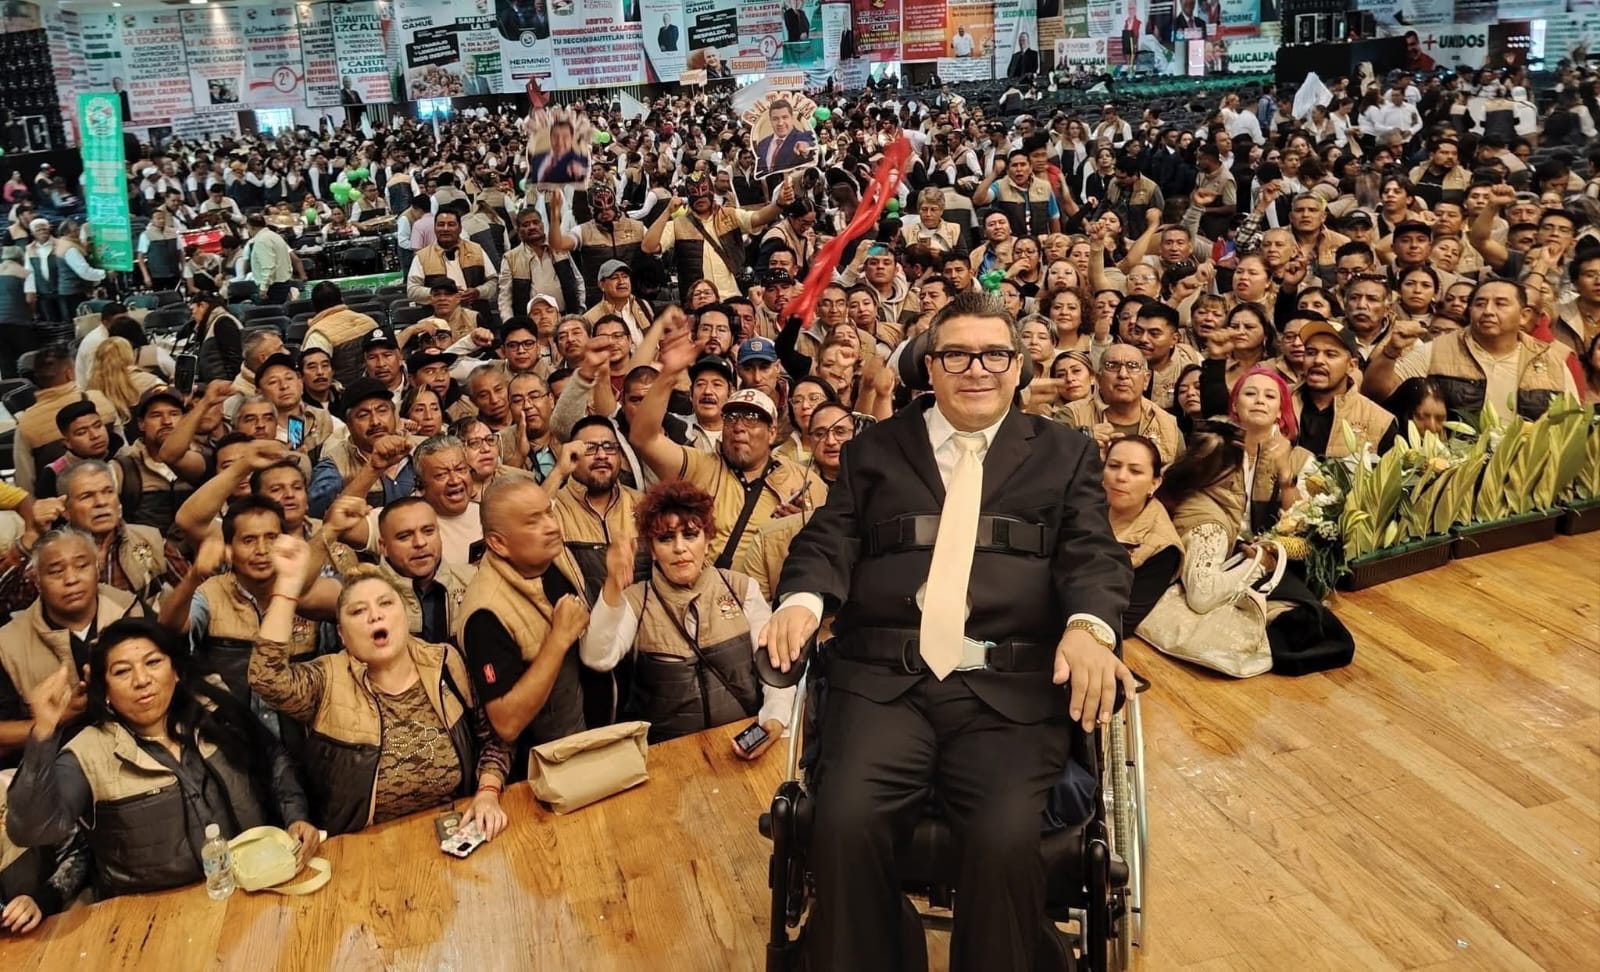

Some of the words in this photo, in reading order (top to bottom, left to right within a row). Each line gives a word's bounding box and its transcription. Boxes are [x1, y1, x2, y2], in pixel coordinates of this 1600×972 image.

[686, 5, 715, 14] CAHUE
[402, 20, 433, 30] CAHUE
[1229, 52, 1275, 63] NAUCALPA
